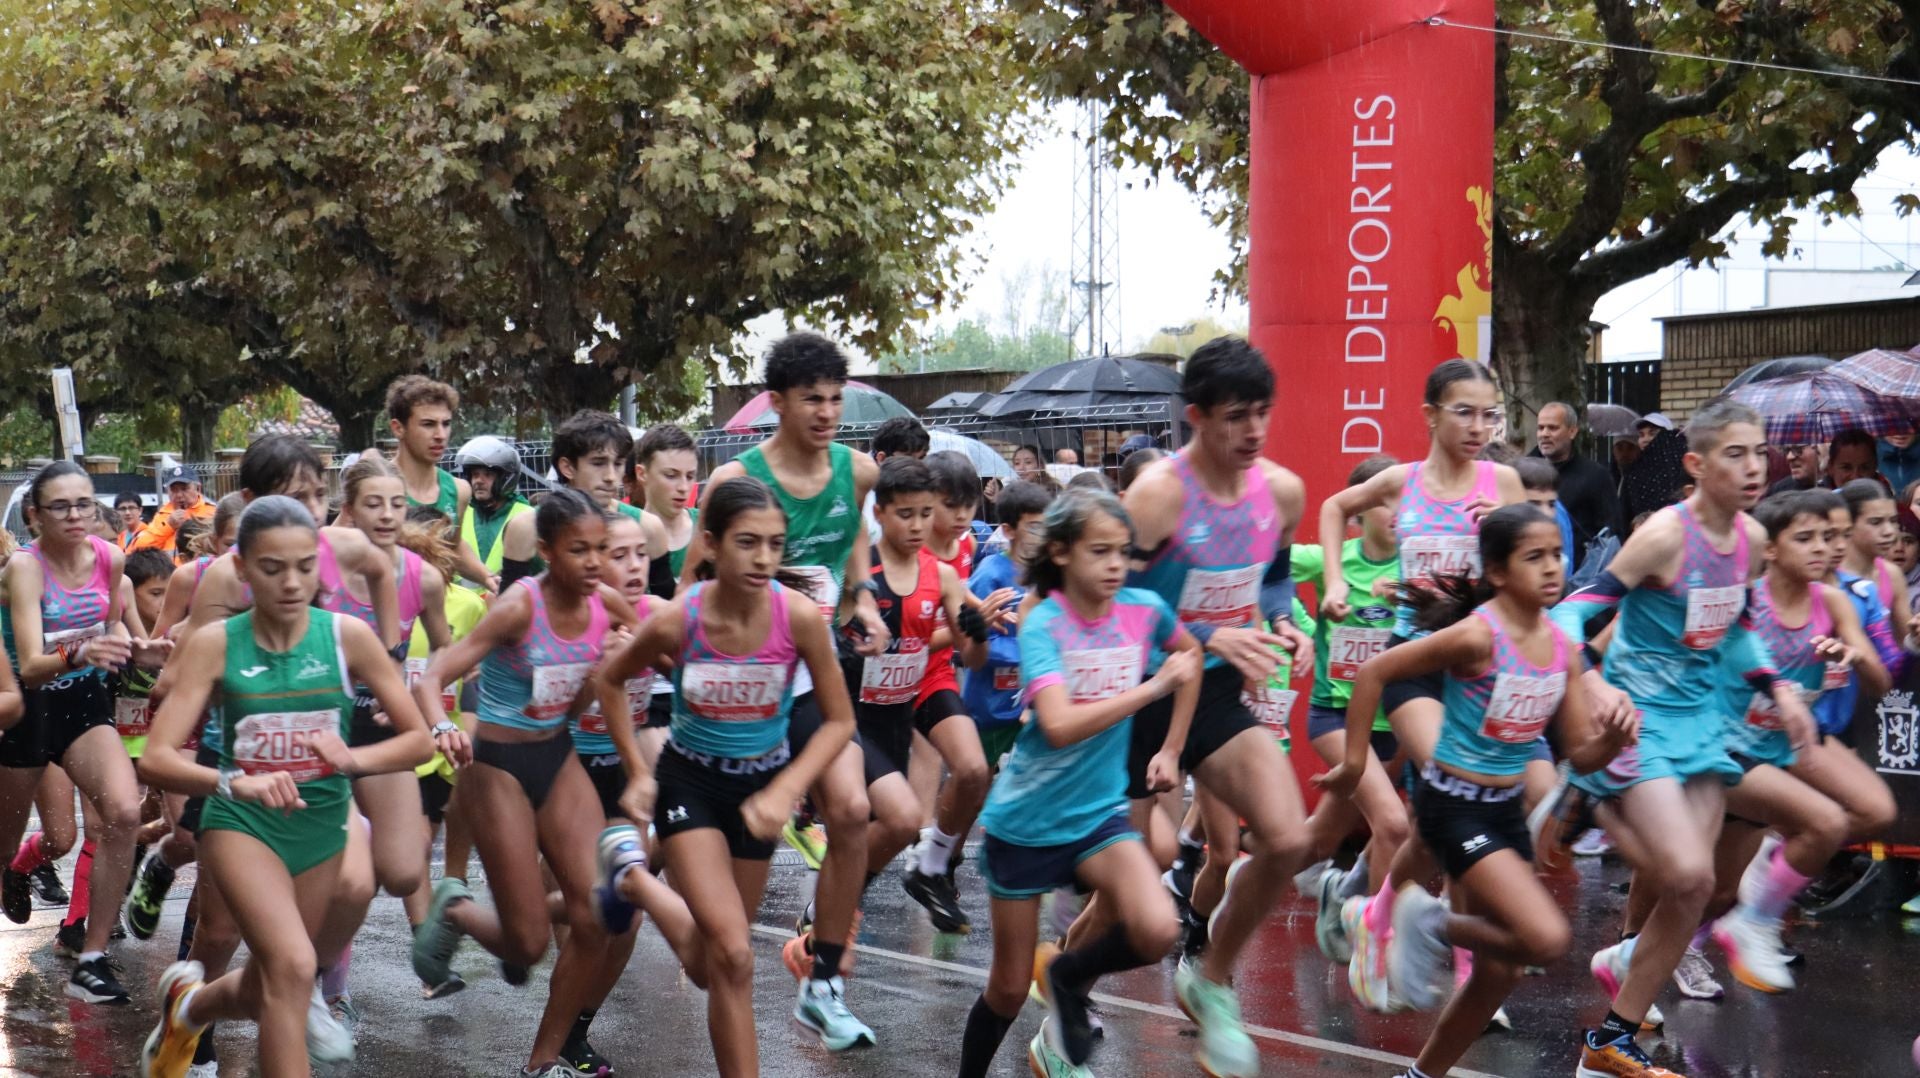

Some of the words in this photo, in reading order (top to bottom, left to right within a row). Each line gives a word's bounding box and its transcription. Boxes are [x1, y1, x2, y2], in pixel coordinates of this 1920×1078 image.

[1343, 95, 1397, 362] DEPORTES
[1341, 388, 1384, 453] DE
[1343, 640, 1390, 662] 205
[702, 681, 767, 704] 2037
